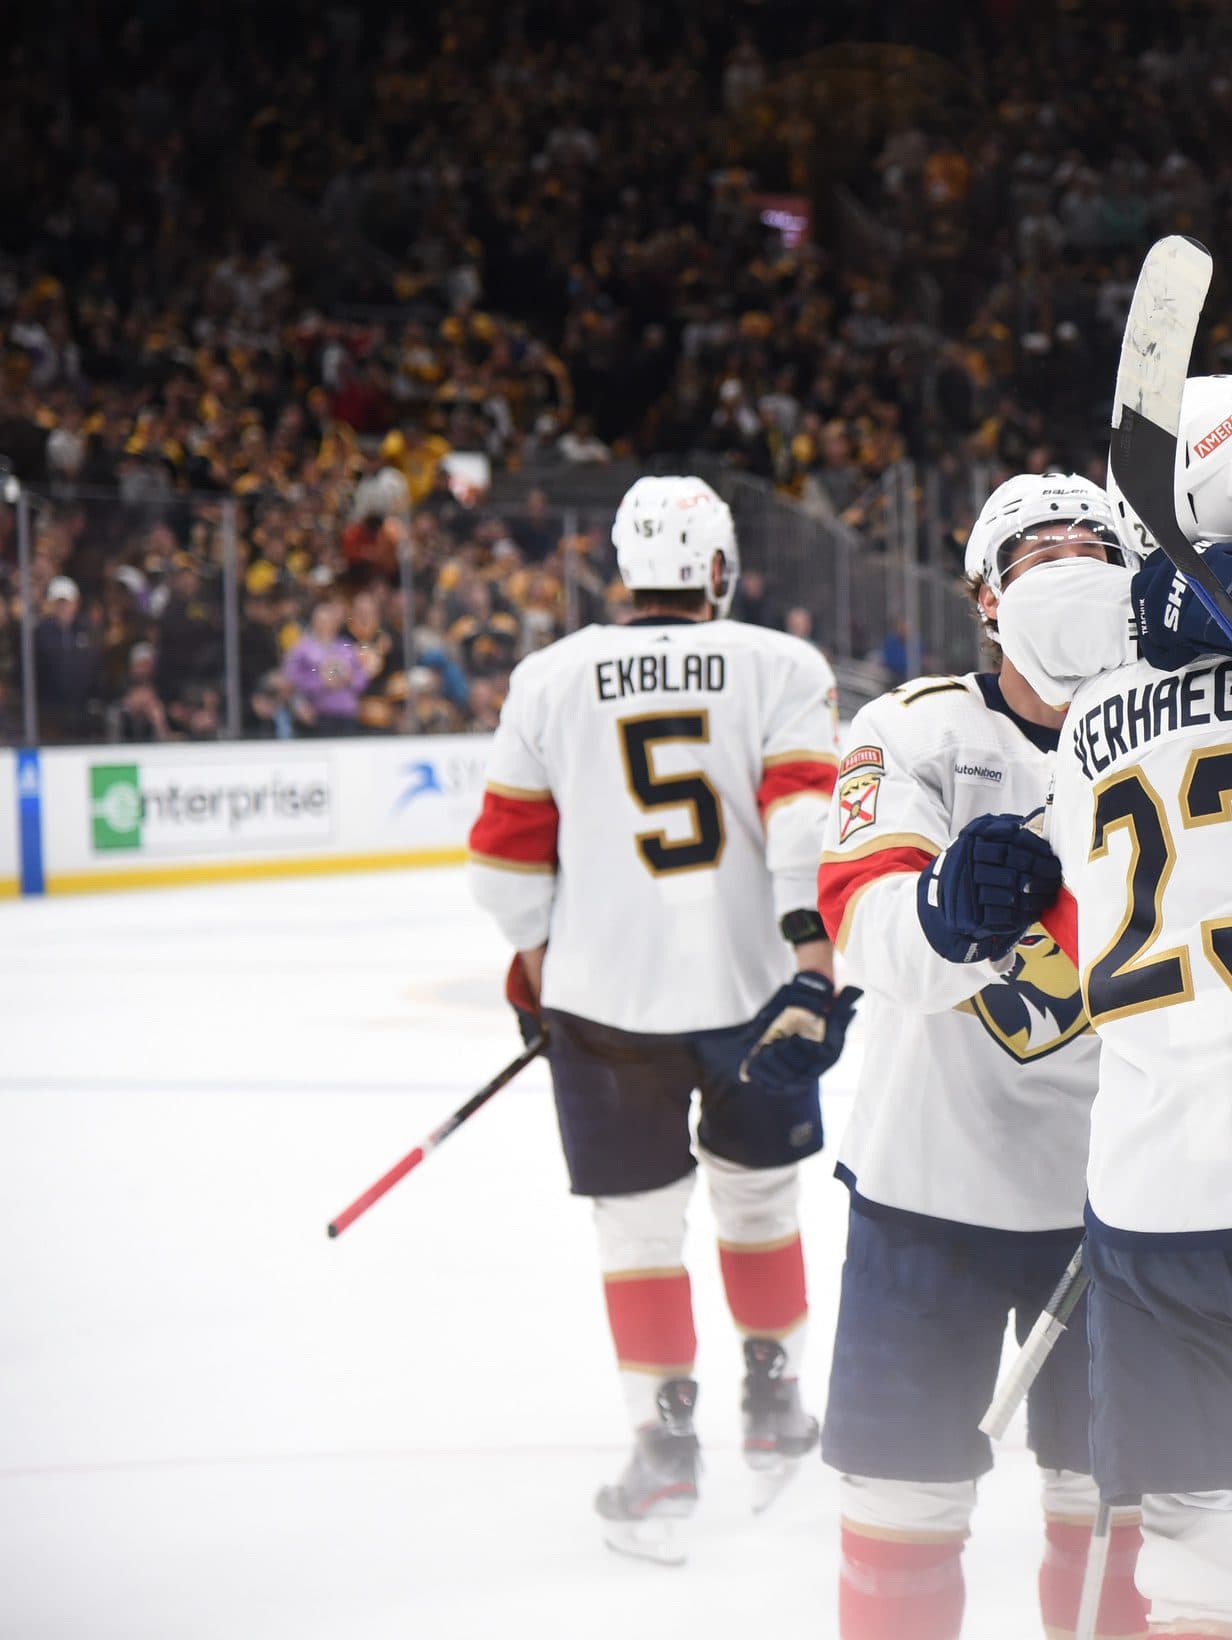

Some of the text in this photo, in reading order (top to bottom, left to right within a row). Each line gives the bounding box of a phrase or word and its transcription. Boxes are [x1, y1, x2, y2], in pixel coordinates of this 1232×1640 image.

[642, 519, 654, 538] 5
[1139, 598, 1149, 635] TKACHUK
[596, 654, 726, 702] EKBLAD
[103, 768, 329, 832] enterprise
[617, 709, 726, 878] 5
